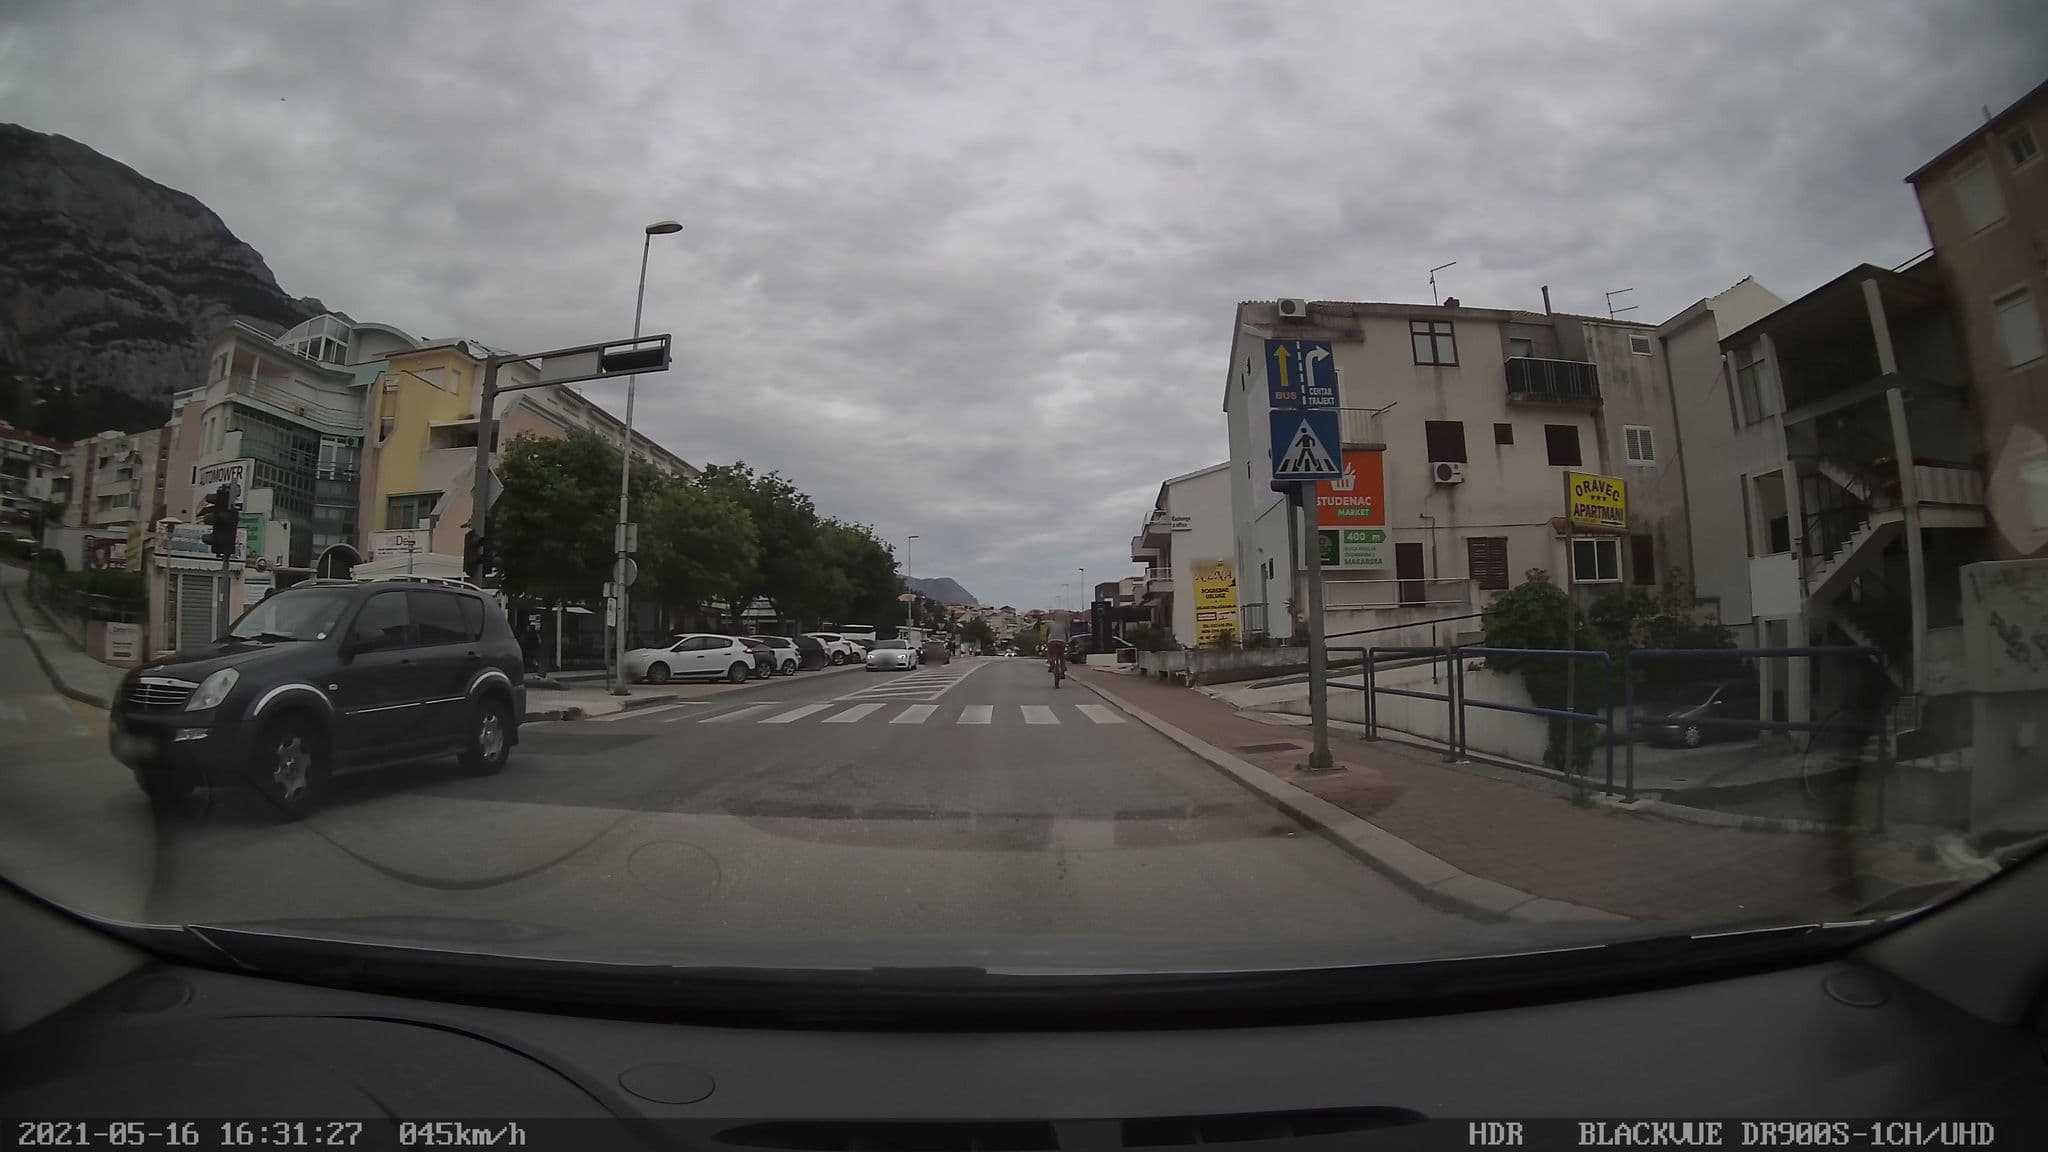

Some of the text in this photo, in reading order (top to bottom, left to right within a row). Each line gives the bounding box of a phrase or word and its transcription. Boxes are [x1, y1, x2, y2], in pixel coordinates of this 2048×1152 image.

[1275, 391, 1297, 400] BUS
[1308, 387, 1333, 396] CENTAR
[1308, 397, 1335, 406] TRAJEKT
[1575, 479, 1620, 501] ORAVEC
[1315, 496, 1372, 506] STUDENAC
[1337, 508, 1370, 517] MARKET
[1573, 503, 1624, 521] APARTMANI
[1347, 532, 1366, 541] 400
